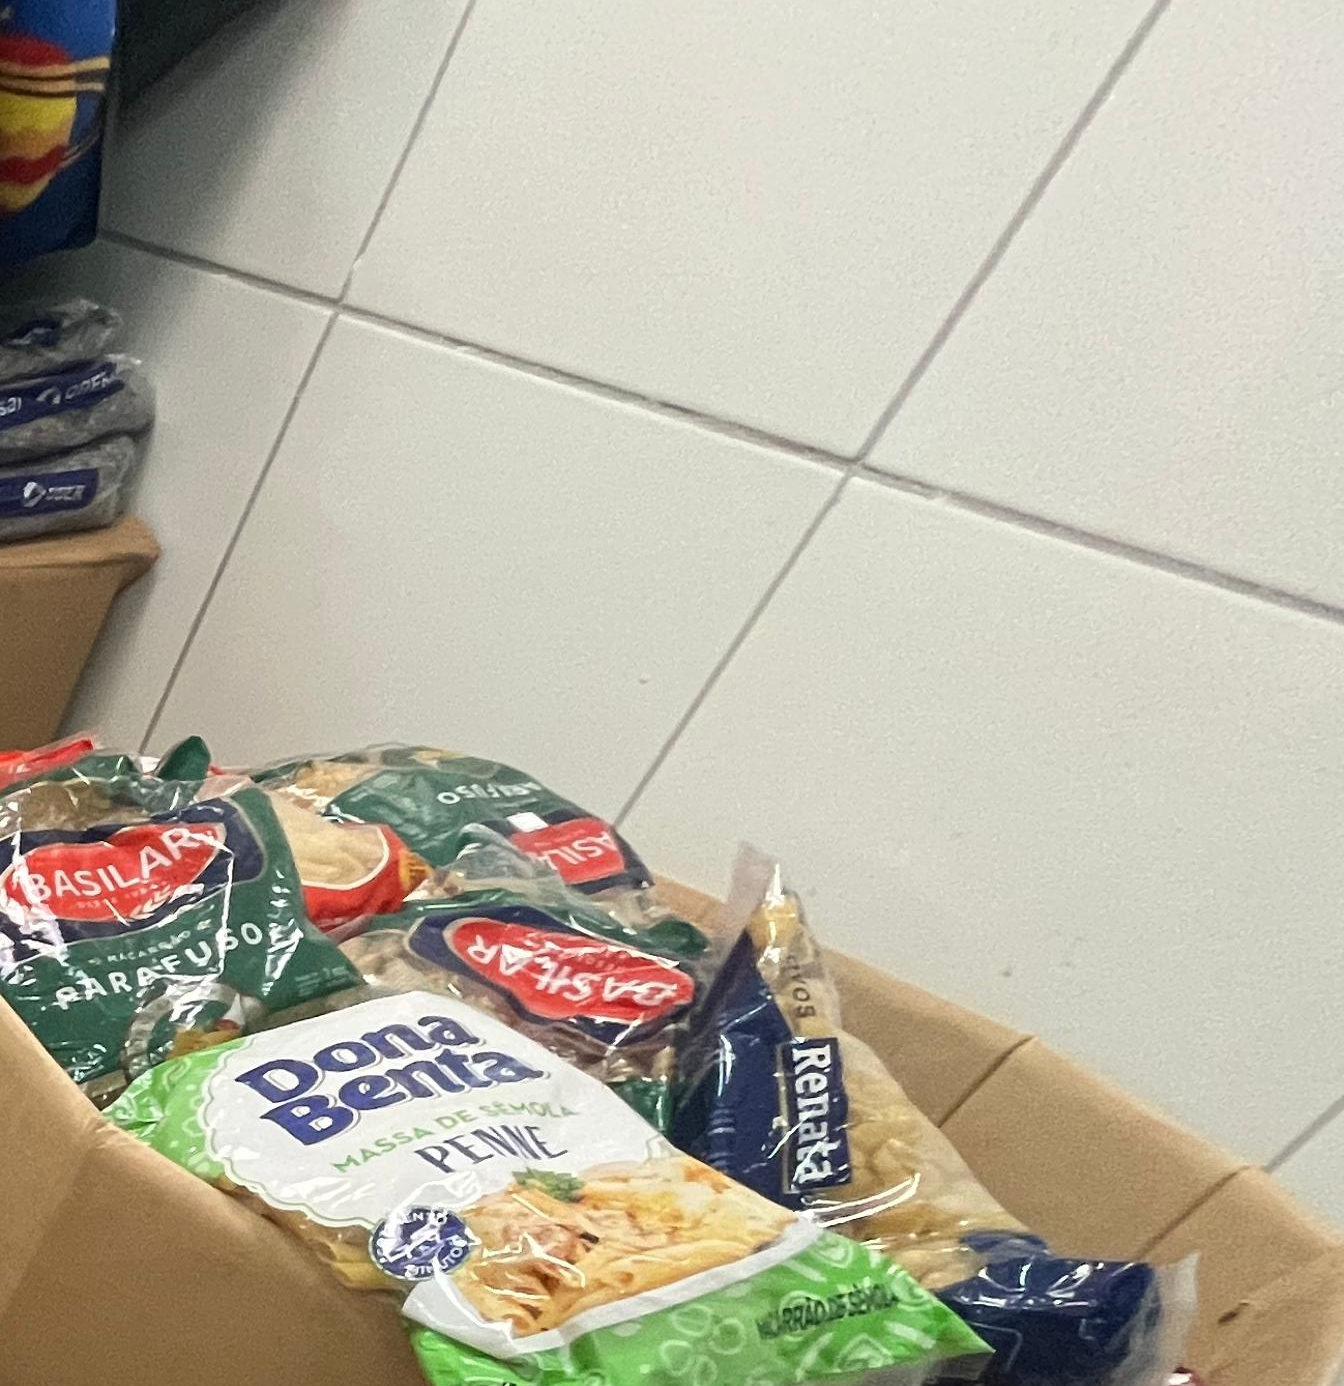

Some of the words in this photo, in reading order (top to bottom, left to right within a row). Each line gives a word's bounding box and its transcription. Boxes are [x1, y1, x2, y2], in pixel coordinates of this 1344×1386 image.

[19, 826, 204, 905] BASILAR
[234, 1014, 483, 1104] Dona
[259, 1047, 546, 1147] Benta
[331, 1125, 437, 1174] MASSA
[434, 1108, 477, 1131] DE
[413, 1123, 570, 1175] PENNE
[790, 1042, 844, 1185] Renata
